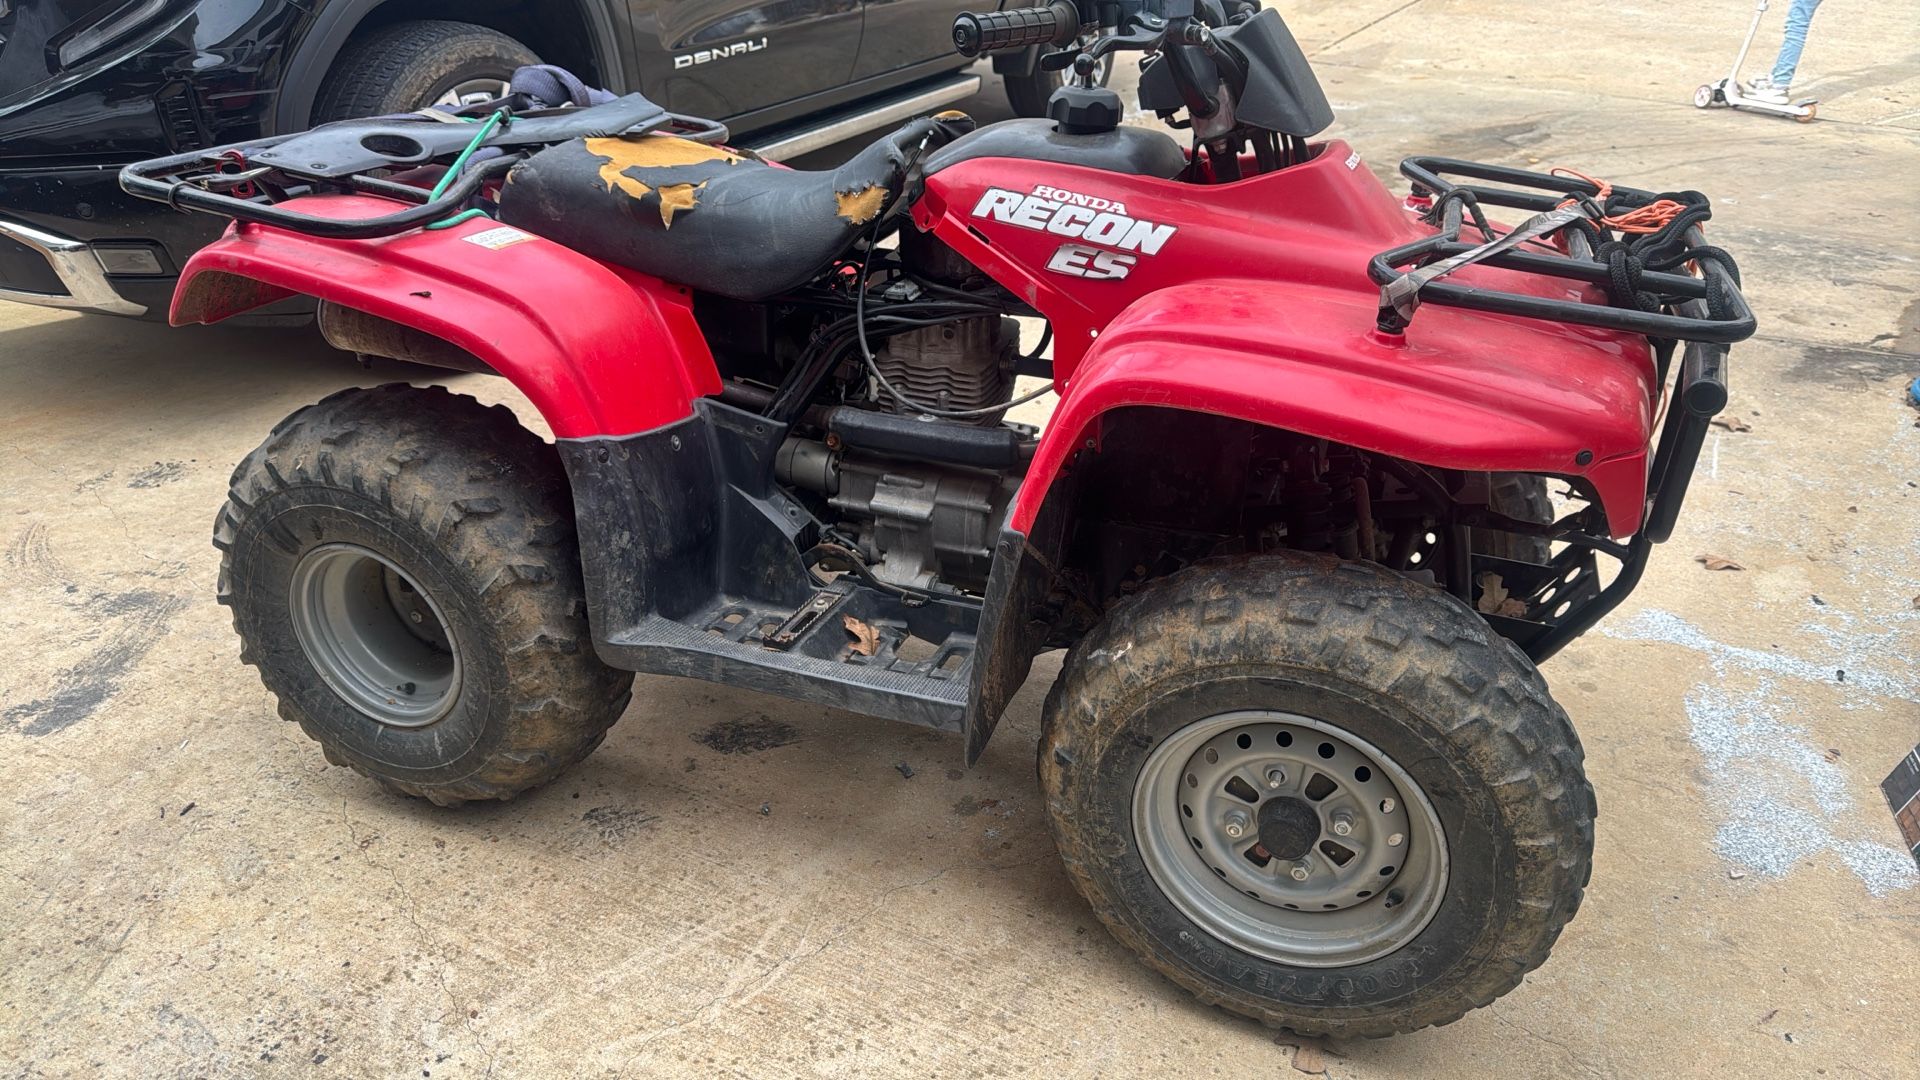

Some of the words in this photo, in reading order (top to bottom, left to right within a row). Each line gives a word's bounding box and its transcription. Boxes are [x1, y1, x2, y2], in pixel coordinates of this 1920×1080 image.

[674, 37, 767, 69] DENALI
[1033, 185, 1127, 215] HONDA
[971, 188, 1178, 256] RECON
[1047, 244, 1138, 280] ES
